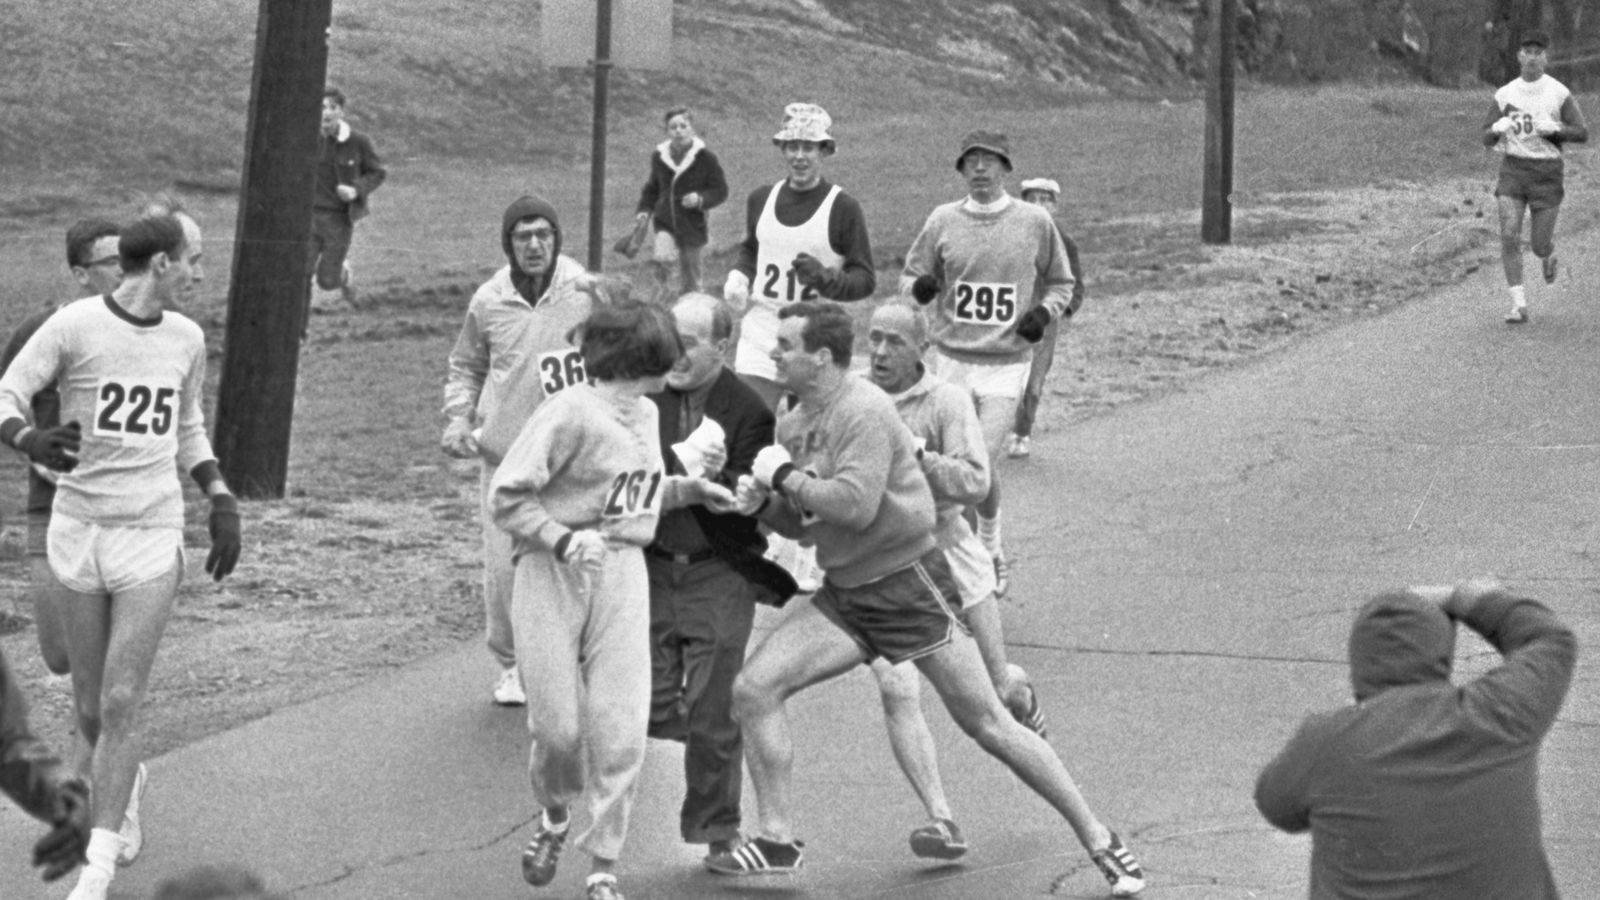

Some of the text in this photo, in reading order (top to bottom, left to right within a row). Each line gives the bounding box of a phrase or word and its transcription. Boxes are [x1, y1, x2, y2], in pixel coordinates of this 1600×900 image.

[957, 283, 1014, 322] 295
[541, 351, 595, 394] 36
[98, 382, 174, 435] 225
[604, 469, 660, 515] 261
